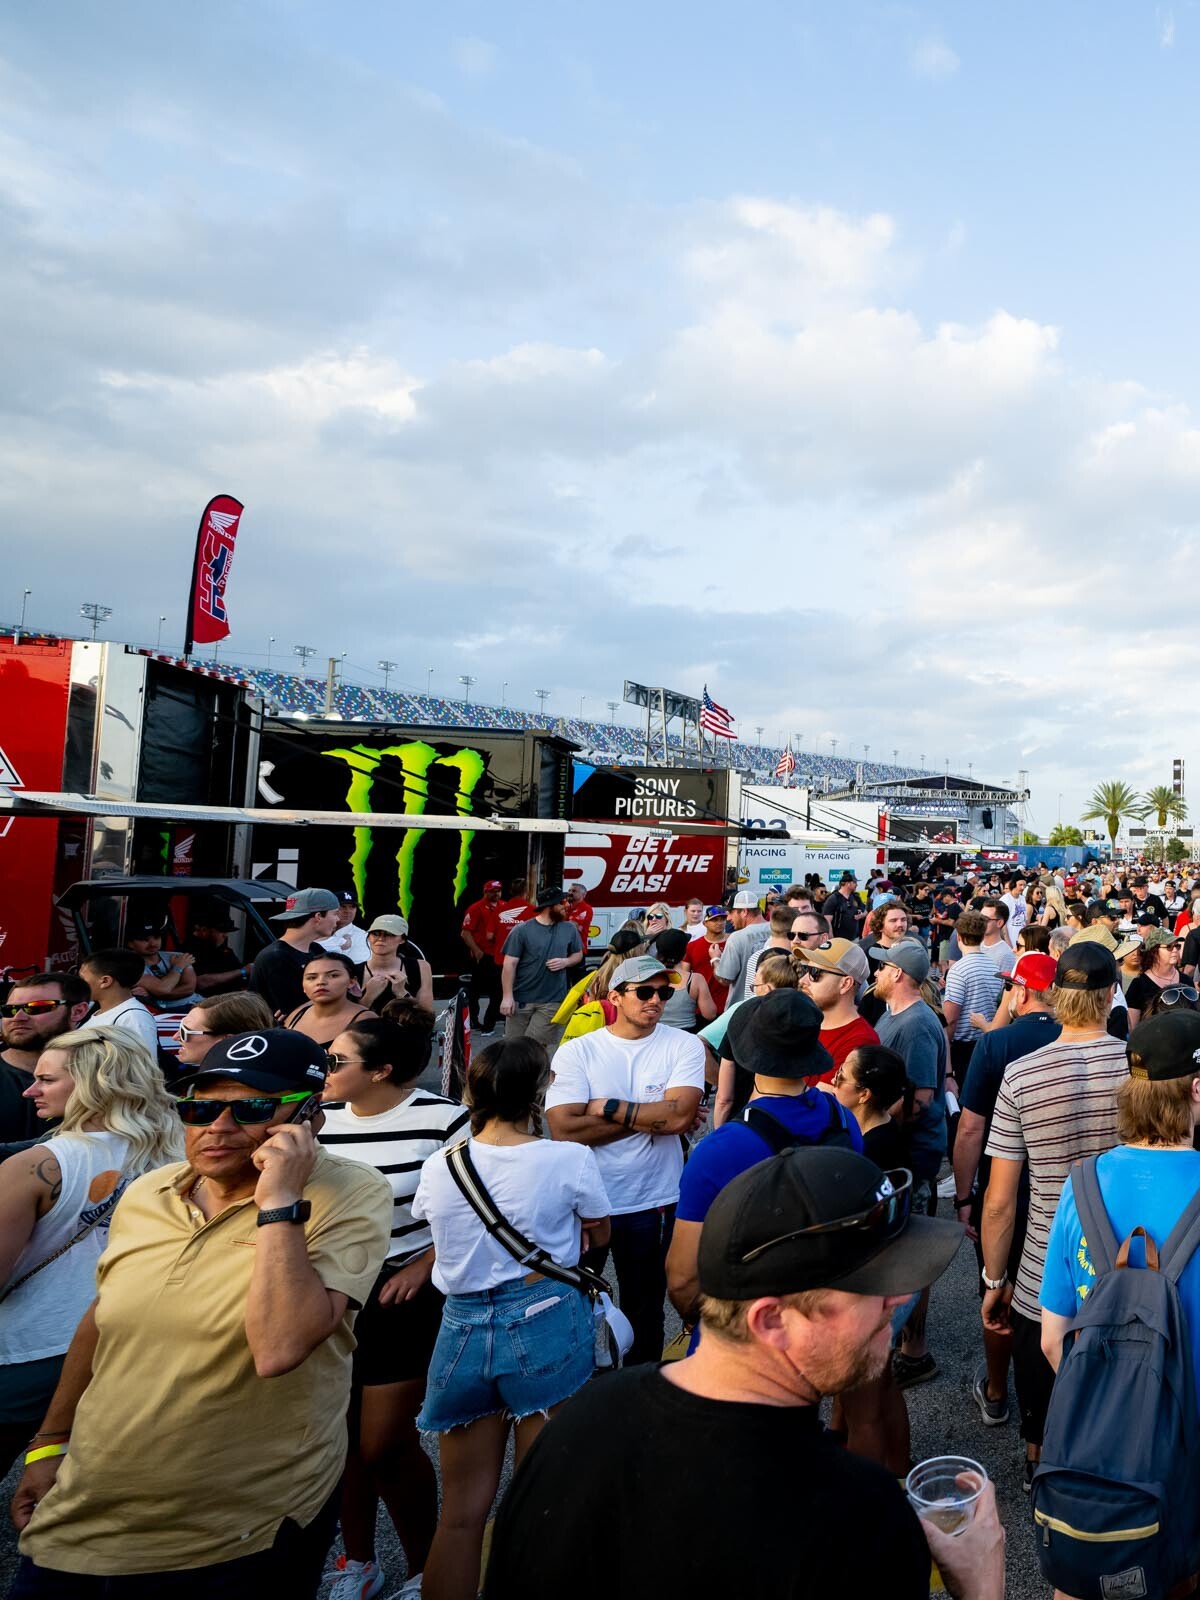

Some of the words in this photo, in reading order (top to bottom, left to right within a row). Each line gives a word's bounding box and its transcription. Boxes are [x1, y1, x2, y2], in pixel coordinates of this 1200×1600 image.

[208, 520, 236, 541] HONDA
[634, 778, 680, 796] SONY
[615, 797, 696, 817] PICTURES
[626, 835, 679, 853] GET
[746, 848, 787, 857] RACING
[618, 854, 659, 872] ON
[664, 855, 714, 873] THE
[988, 851, 1015, 859] FXR
[610, 874, 672, 893] GAS!
